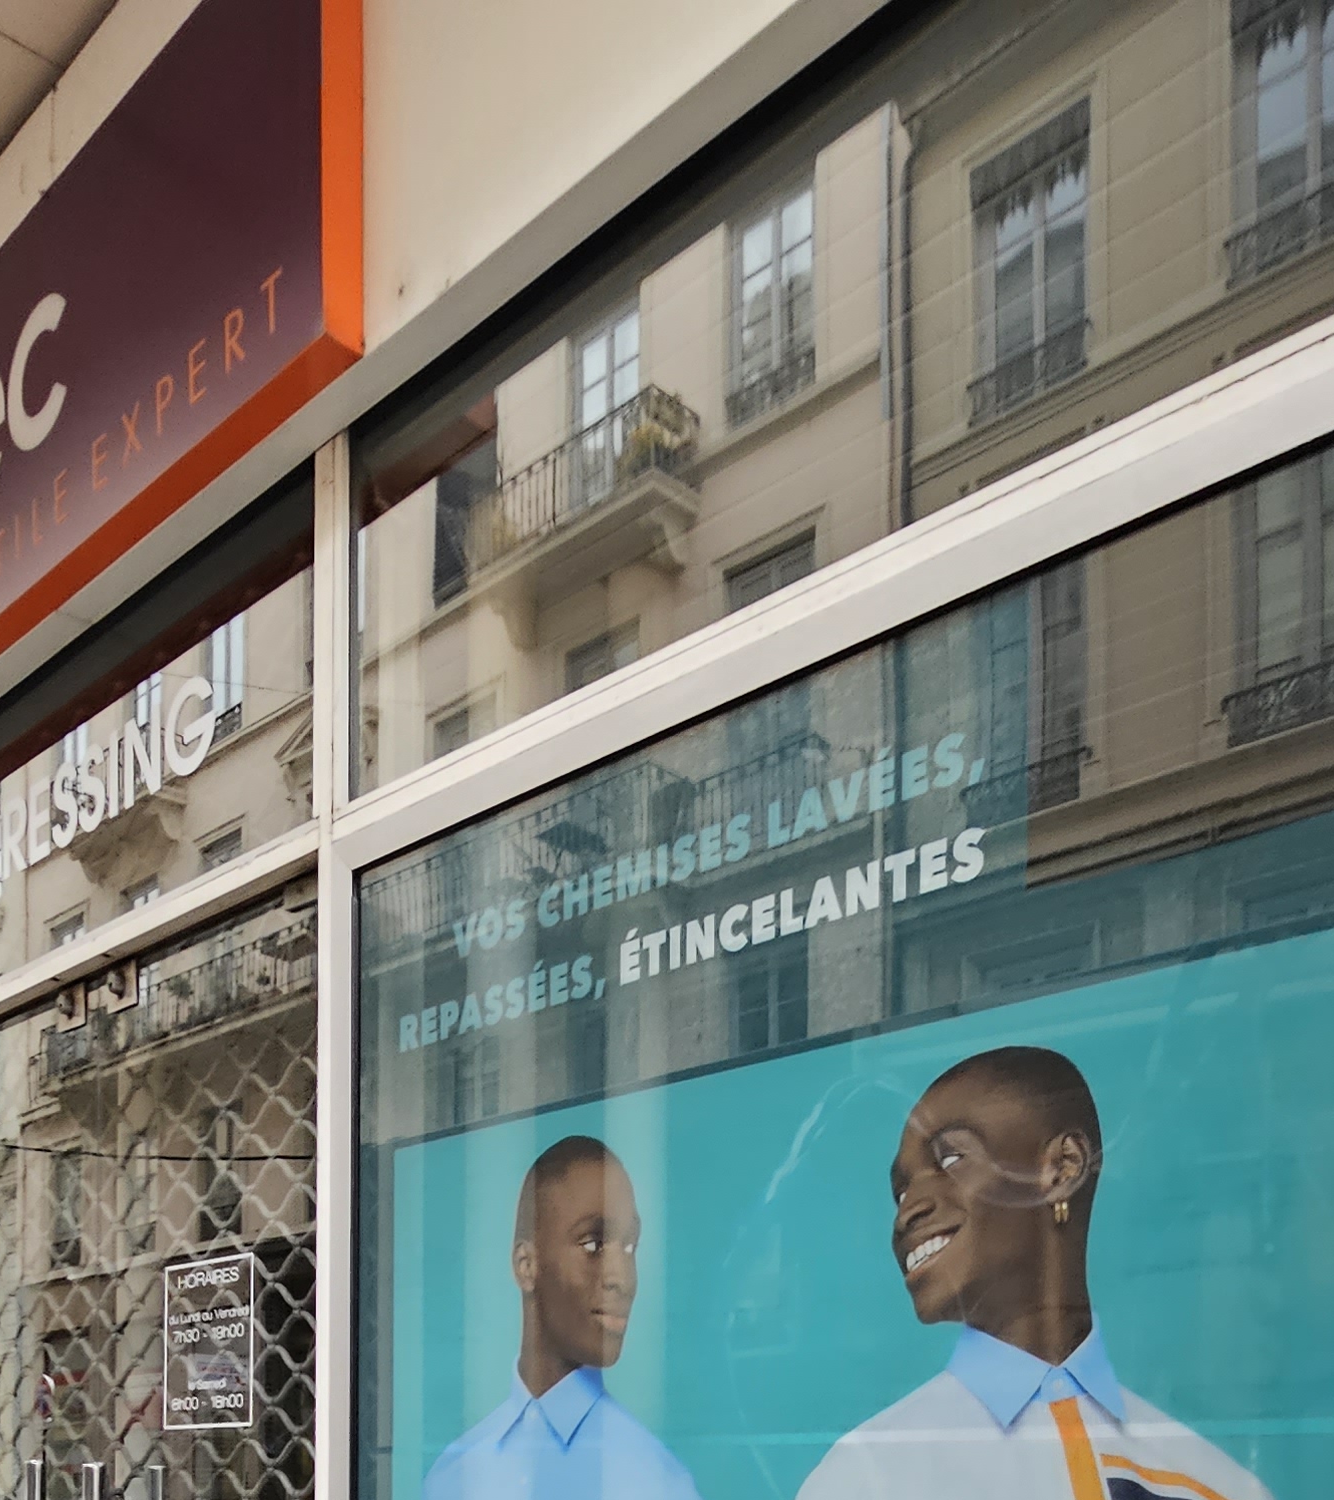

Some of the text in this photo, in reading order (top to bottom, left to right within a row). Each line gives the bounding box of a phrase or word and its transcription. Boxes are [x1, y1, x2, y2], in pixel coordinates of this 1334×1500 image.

[91, 267, 283, 491] EXPERT
[399, 826, 988, 1053] REPASSÉES, ÉTINCELANTES
[452, 731, 985, 959] VOS CHEMISES LAVÉES,
[172, 1327, 200, 1344] 7h30
[177, 1266, 240, 1289] HORAIRES
